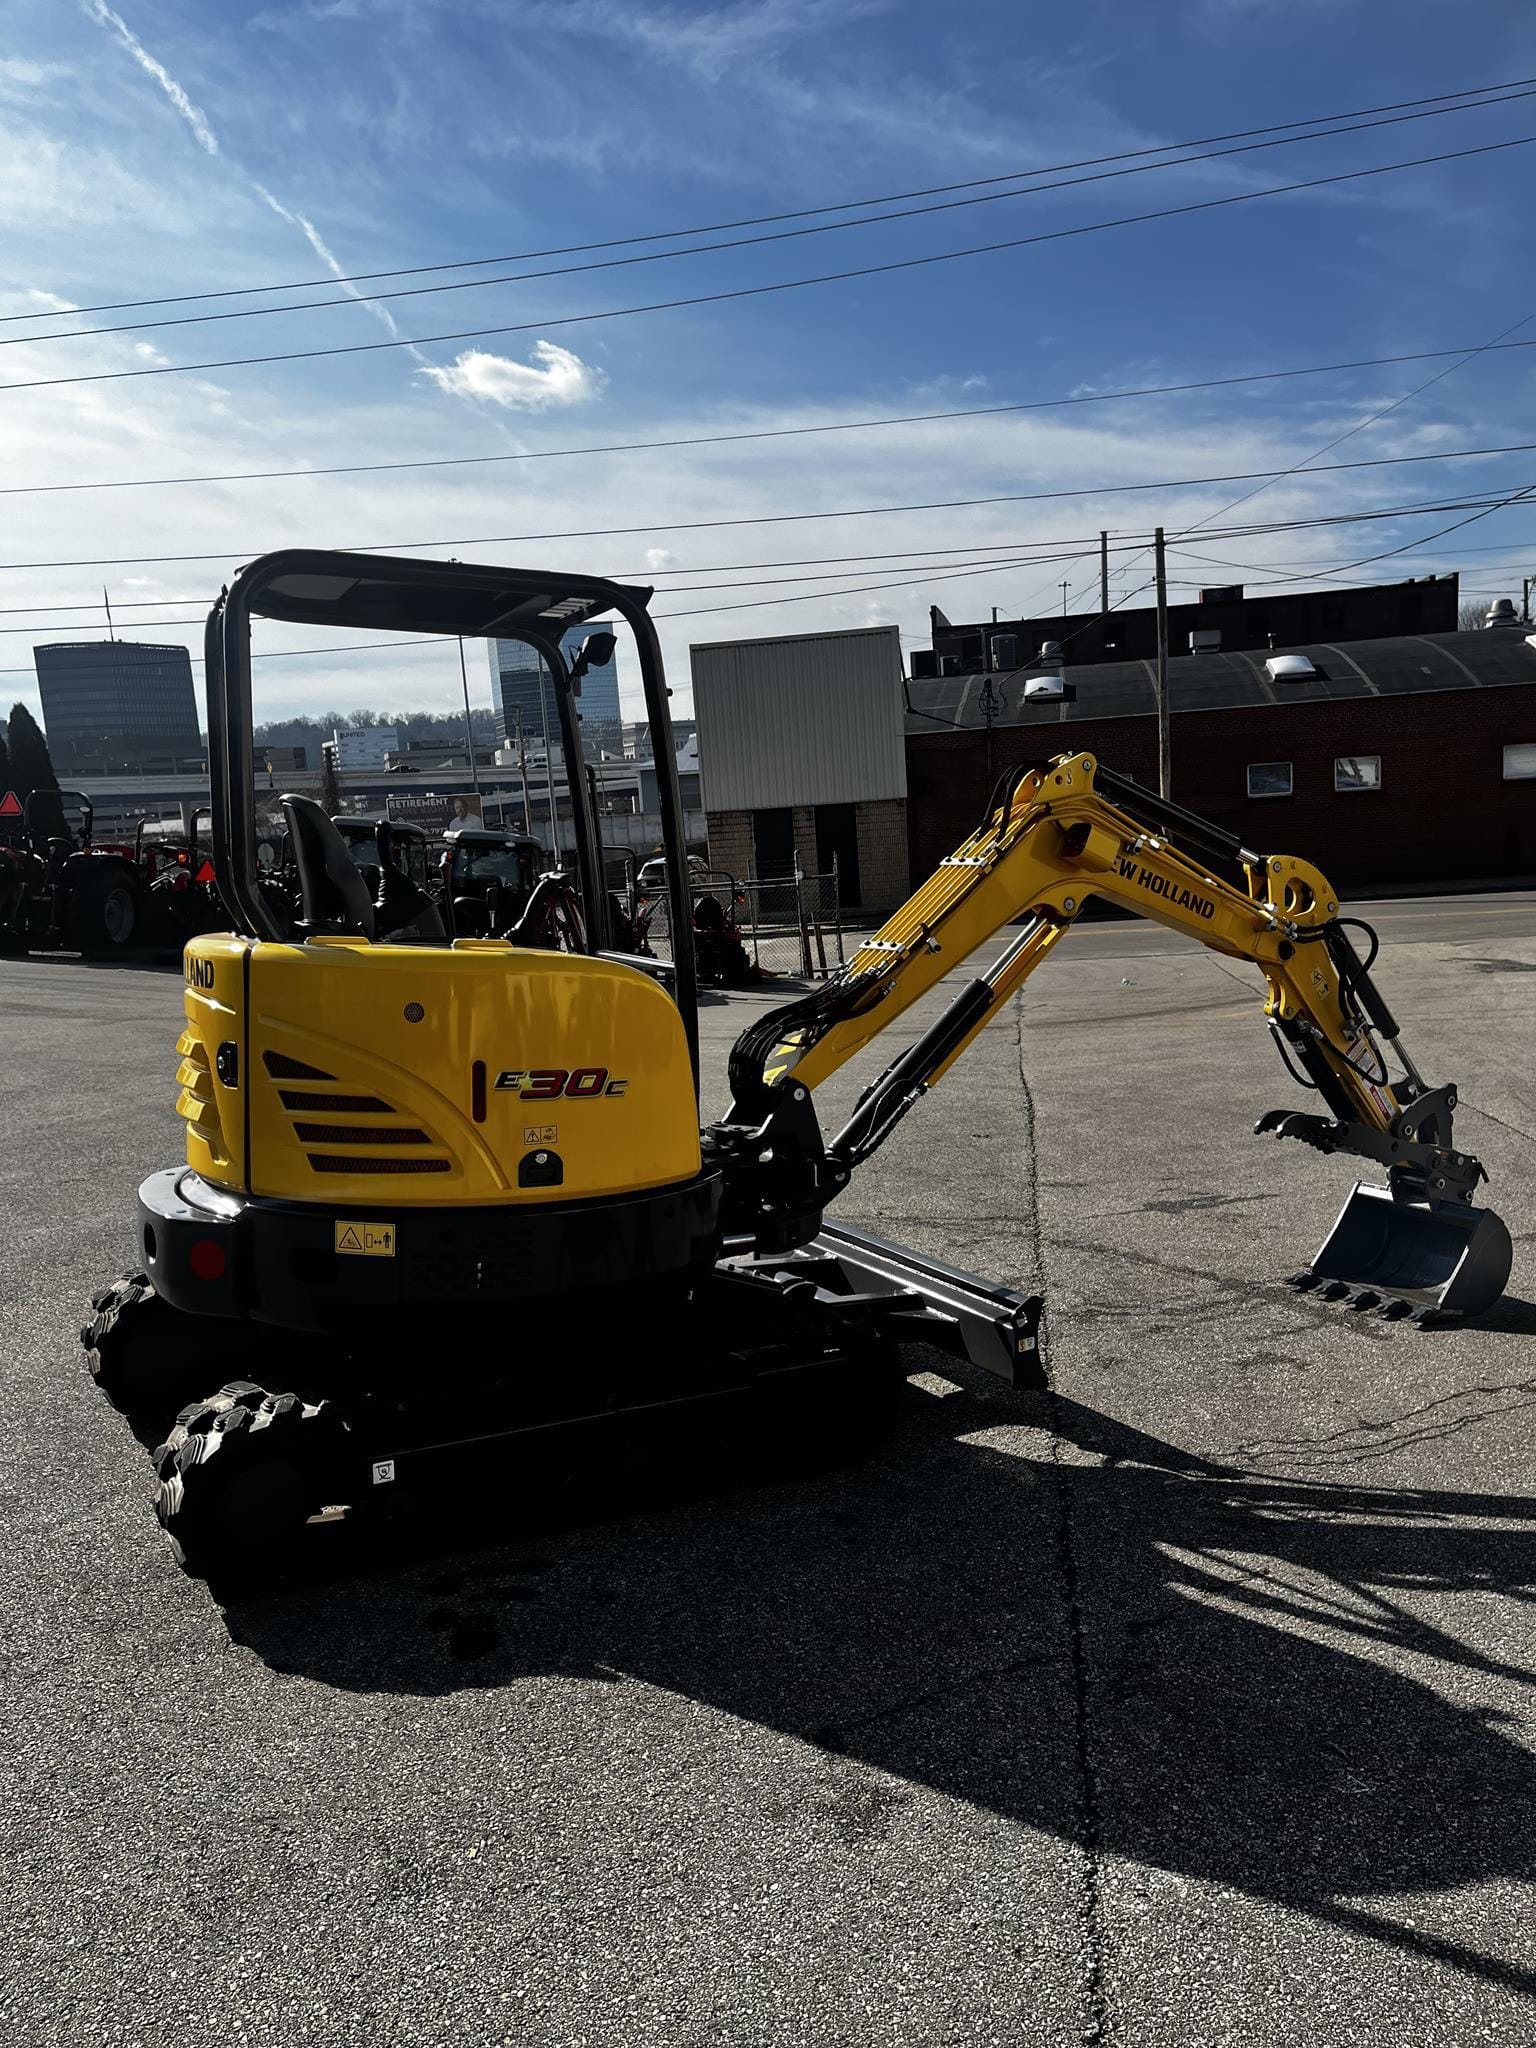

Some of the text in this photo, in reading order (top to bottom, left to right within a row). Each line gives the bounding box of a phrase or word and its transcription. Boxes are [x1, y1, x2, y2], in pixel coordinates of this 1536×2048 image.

[389, 798, 448, 809] RETIREMENT
[1111, 855, 1215, 919] EW HOLLAND
[185, 957, 215, 989] LAND
